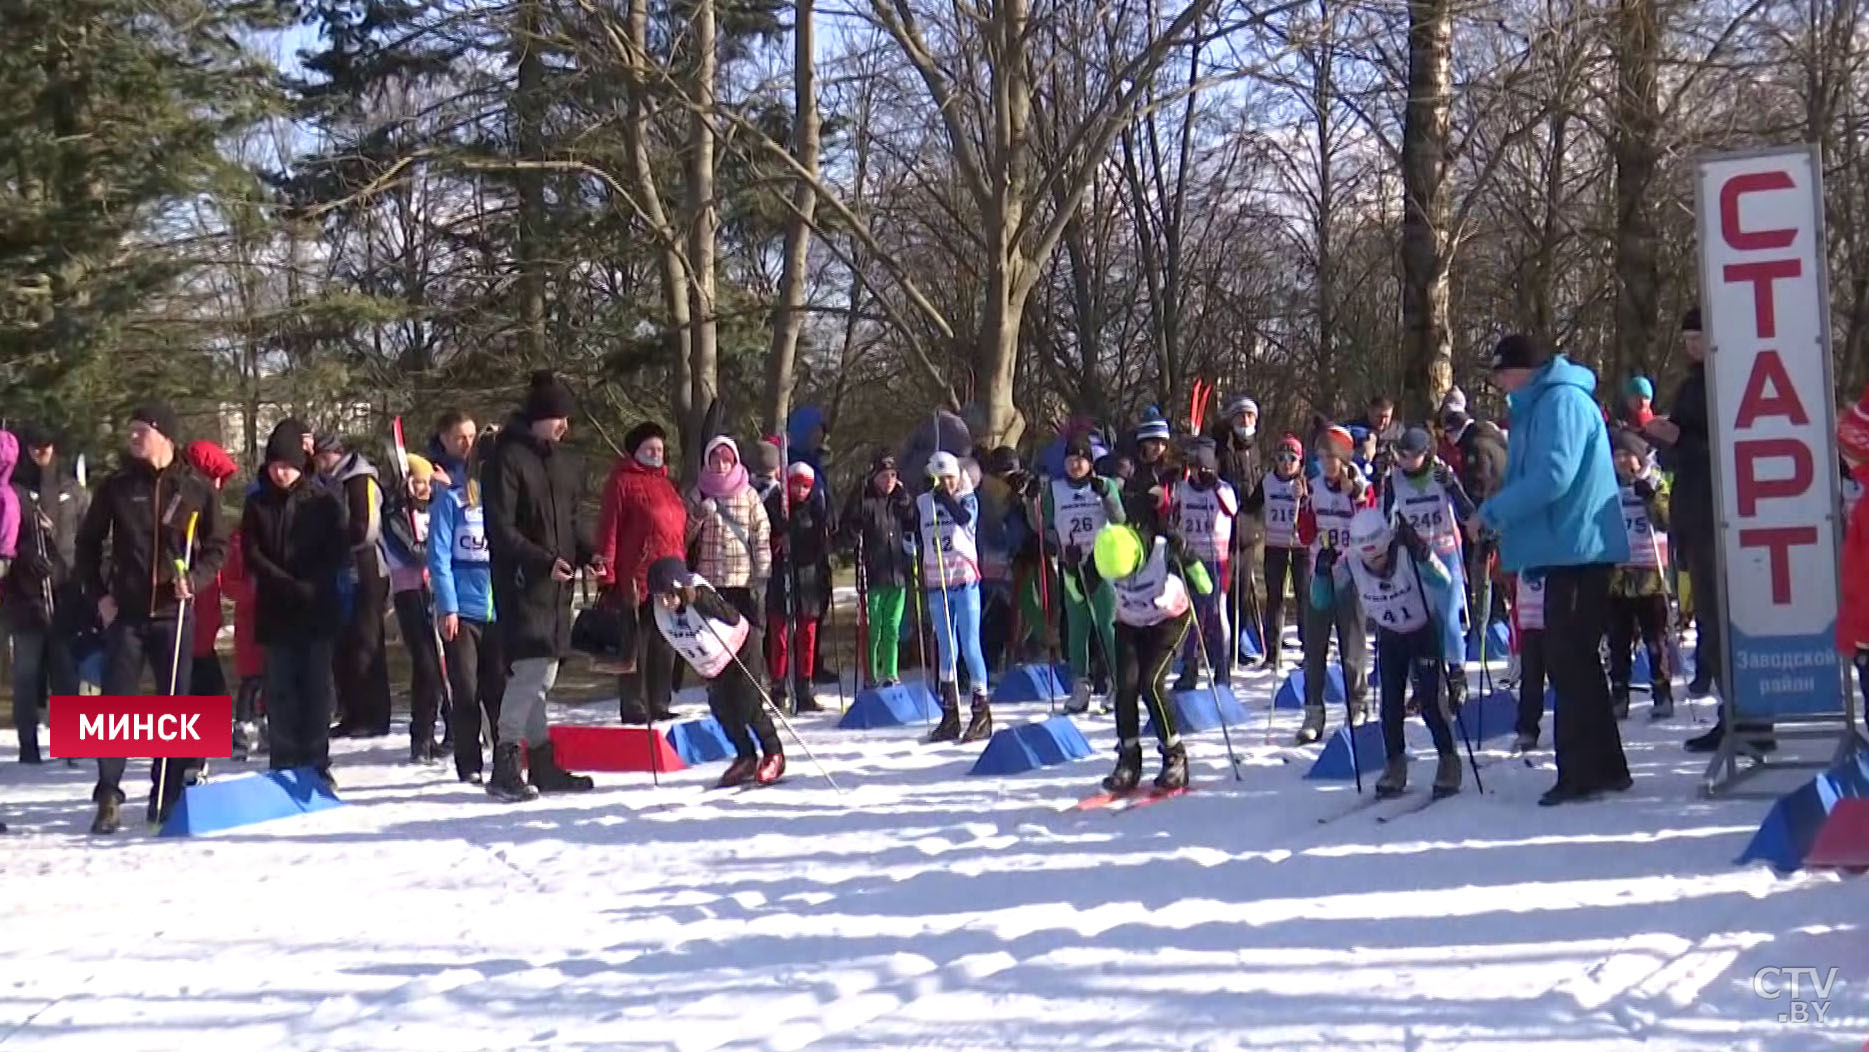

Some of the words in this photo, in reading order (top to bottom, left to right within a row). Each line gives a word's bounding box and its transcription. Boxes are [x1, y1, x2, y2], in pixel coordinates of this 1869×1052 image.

[1719, 171, 1817, 605] СТАРТ
[1070, 517, 1093, 532] 26
[460, 535, 489, 552] СУ
[1737, 649, 1837, 670] Заводской
[1760, 675, 1815, 696] район
